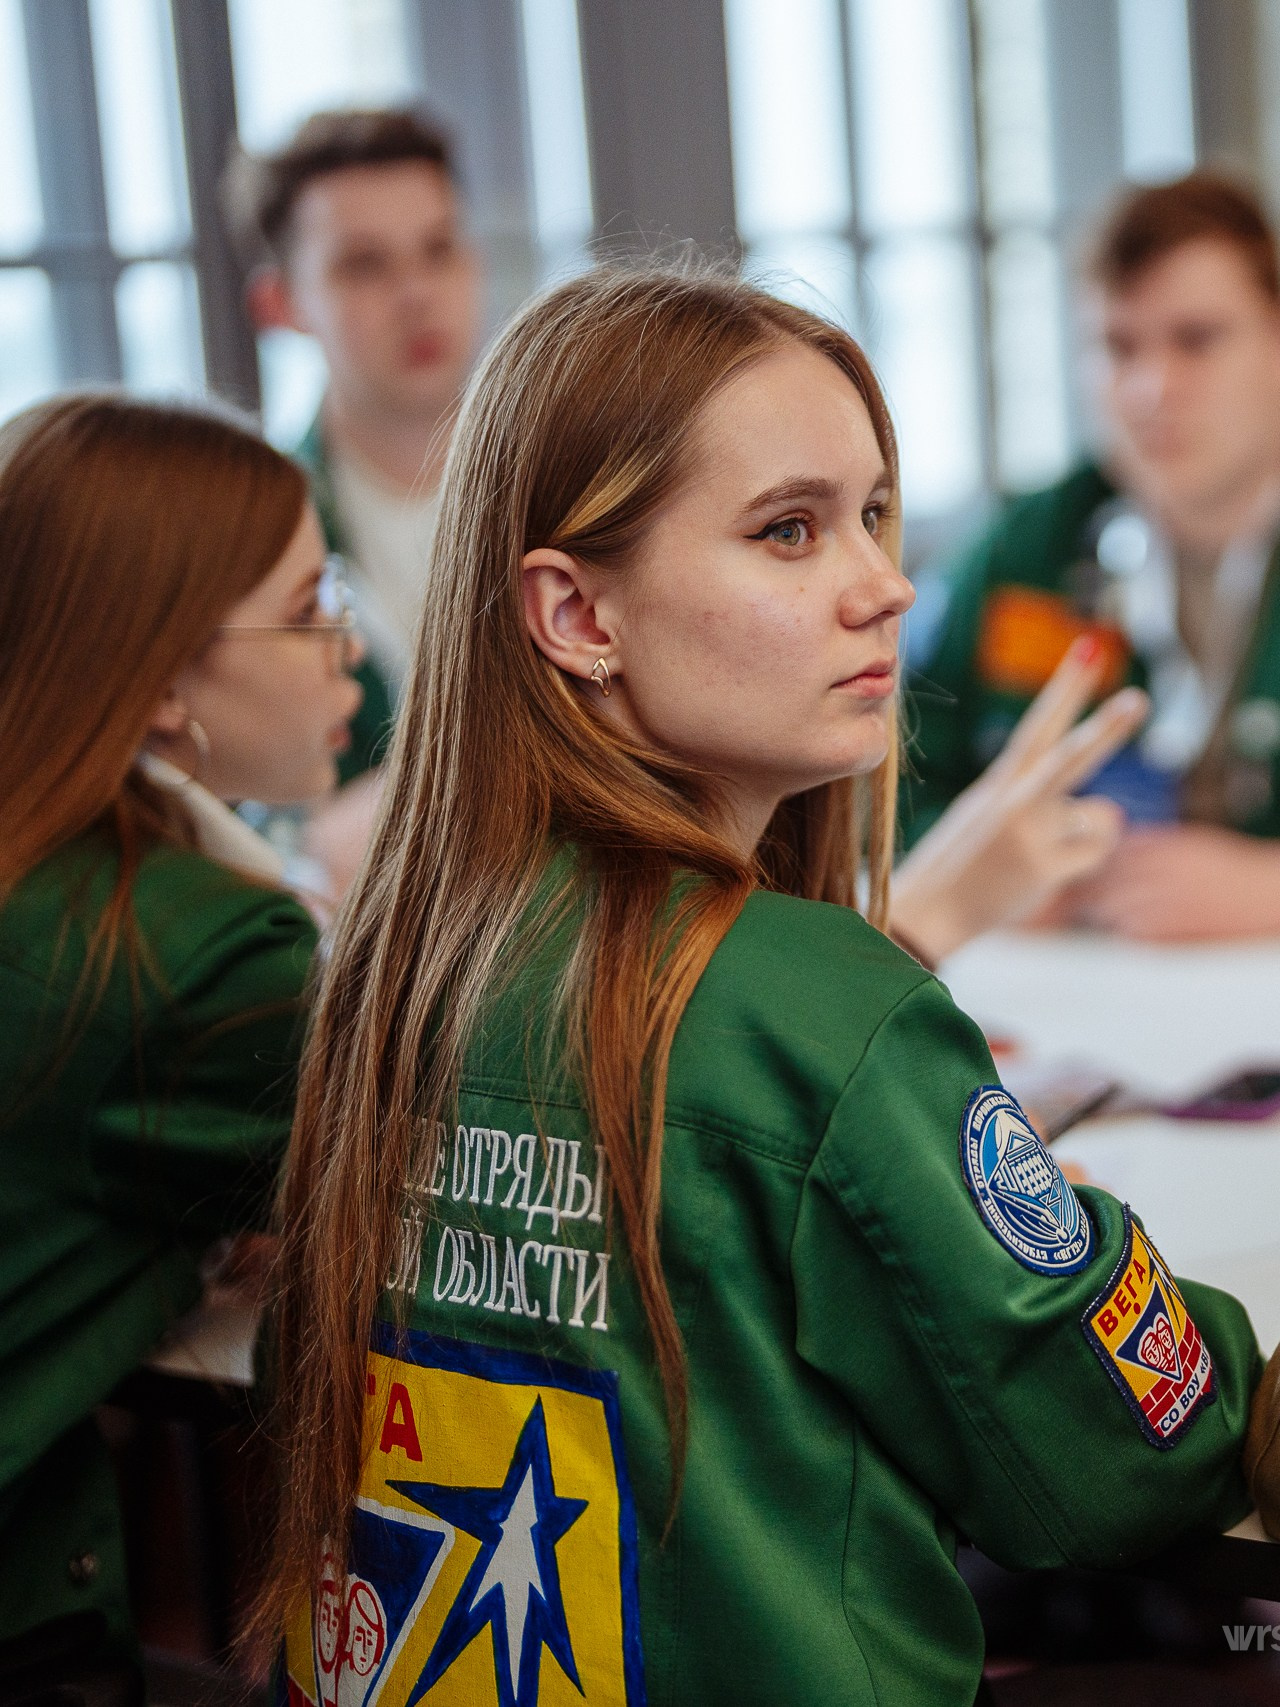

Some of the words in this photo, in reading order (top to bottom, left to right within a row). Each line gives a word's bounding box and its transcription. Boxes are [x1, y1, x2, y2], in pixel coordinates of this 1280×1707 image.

[452, 1124, 606, 1235] ОТРЯДЫ
[433, 1225, 611, 1332] ОБЛАСТИ
[1097, 1258, 1146, 1337] ВЕГА
[1160, 1408, 1180, 1432] СО
[1180, 1373, 1201, 1407] ВОУ
